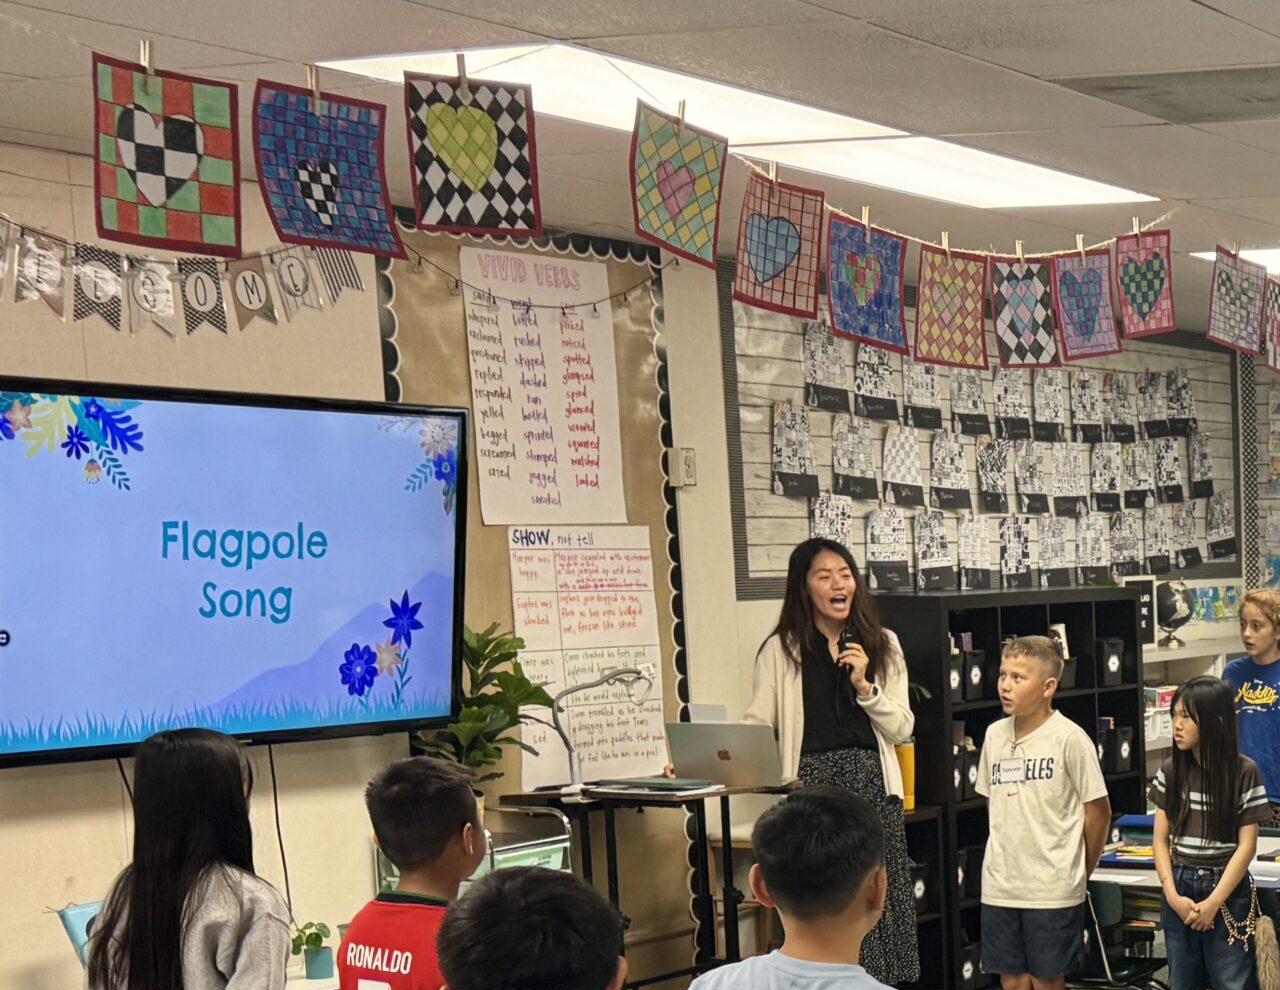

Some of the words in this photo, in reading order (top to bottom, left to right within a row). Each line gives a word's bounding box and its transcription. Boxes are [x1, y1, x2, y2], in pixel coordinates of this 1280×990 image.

[477, 254, 527, 283] VIVID
[534, 263, 580, 291] VERBS
[515, 352, 546, 372] skipped
[562, 352, 591, 366] spotted
[480, 427, 508, 446] begged
[480, 443, 517, 460] screamed
[161, 520, 328, 570] Flagpole
[557, 533, 572, 546] not
[576, 532, 594, 546] tell
[198, 581, 293, 624] Song
[1026, 757, 1055, 780] ELES
[347, 942, 412, 974] RONALDO
